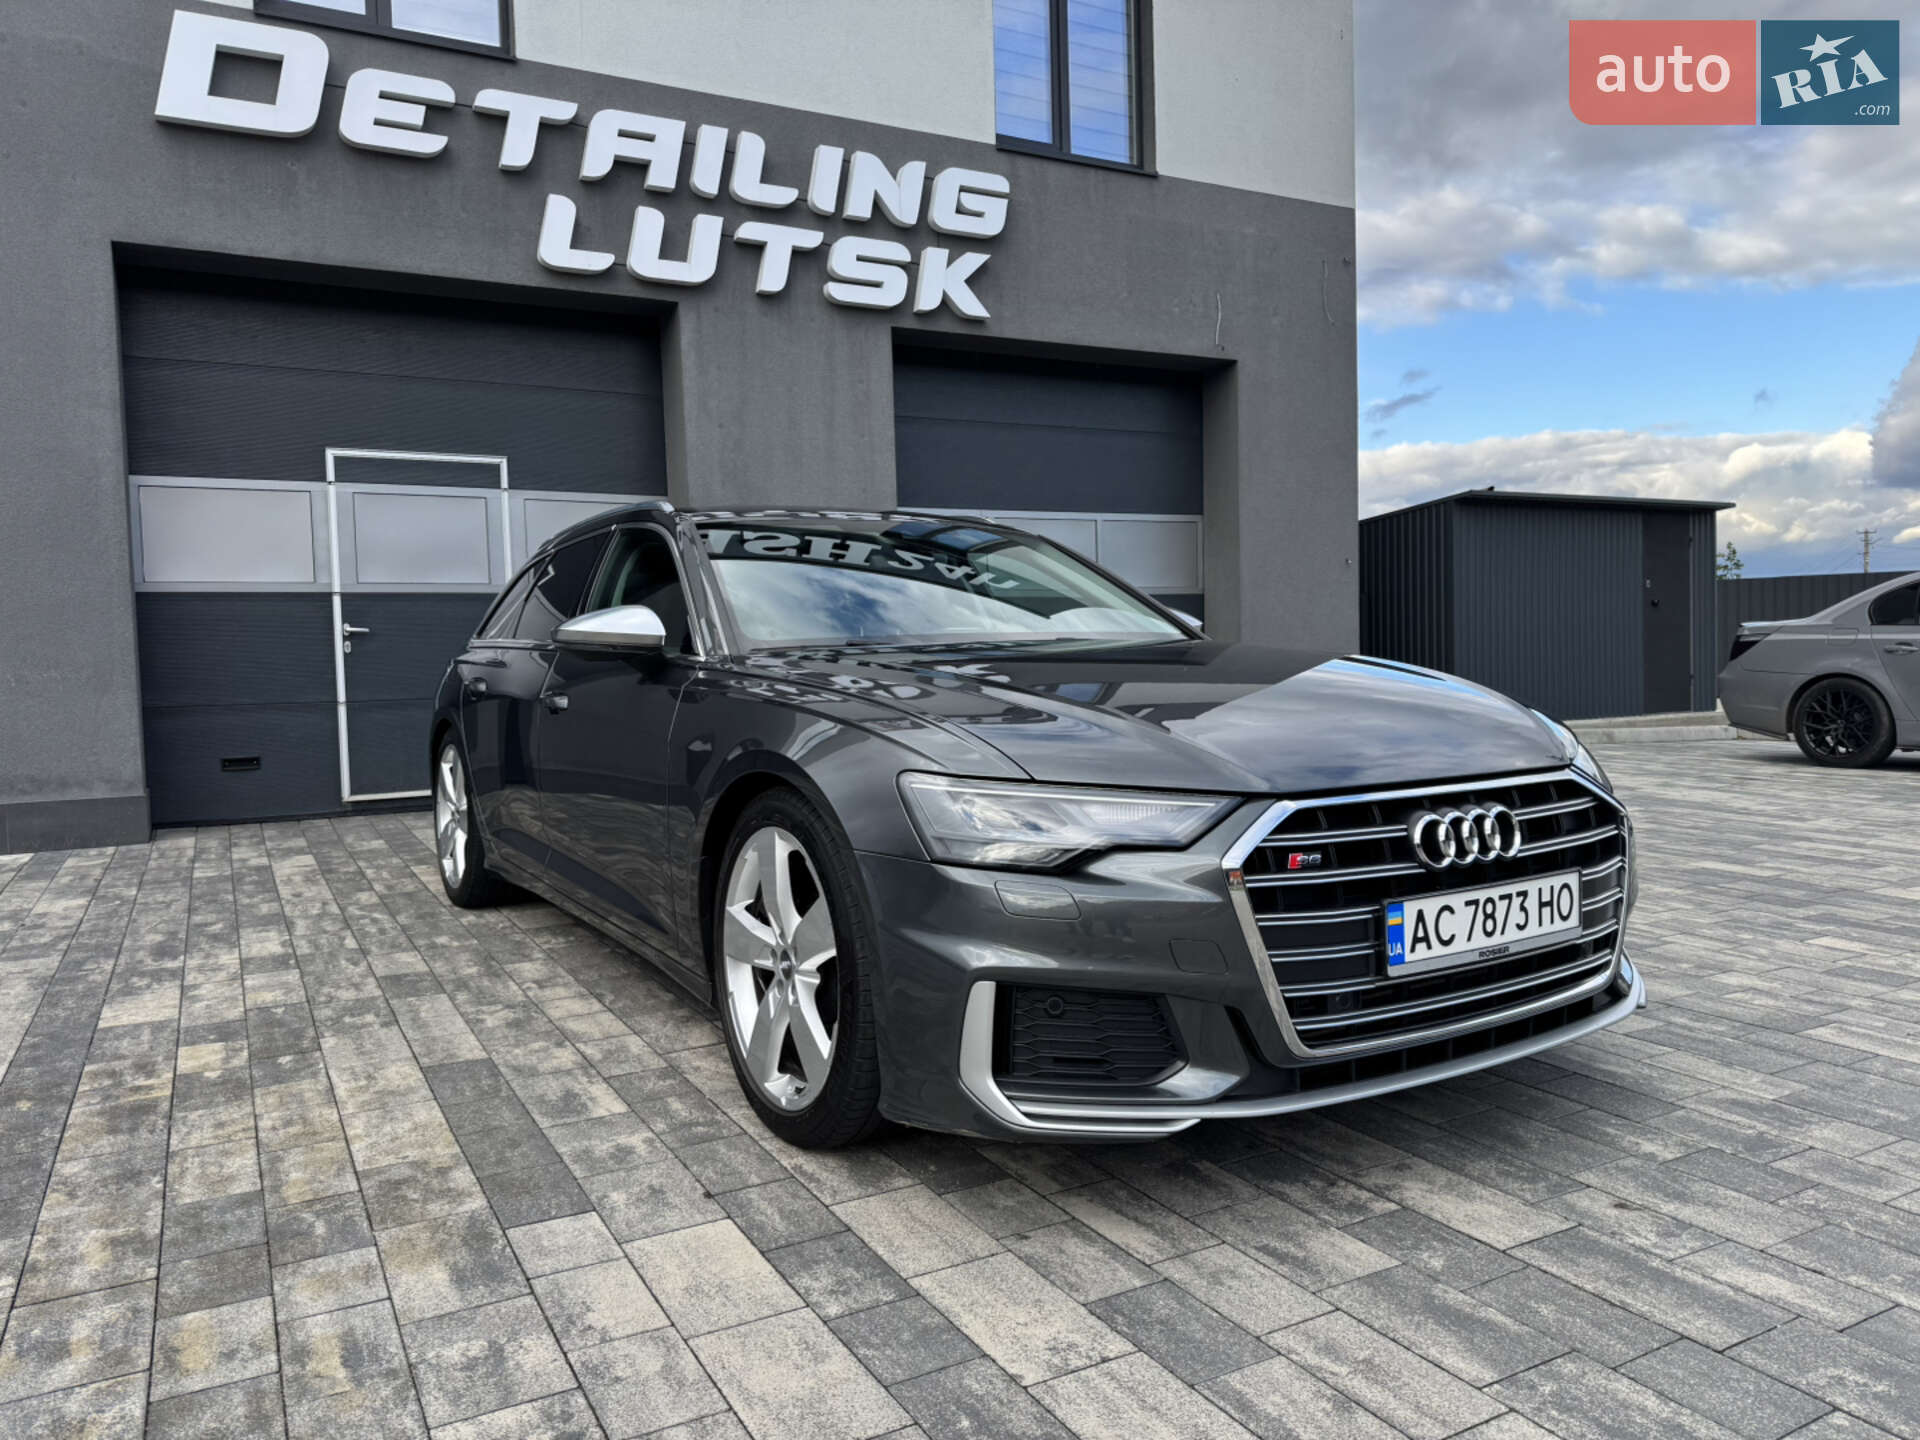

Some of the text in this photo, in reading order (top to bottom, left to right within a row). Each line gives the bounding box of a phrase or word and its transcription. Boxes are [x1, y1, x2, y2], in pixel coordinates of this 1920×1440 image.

[155, 10, 1011, 240] DETAILING
[537, 193, 991, 321] LUTSK
[1387, 942, 1404, 957] UA
[1410, 882, 1575, 954] AC 7873 HO
